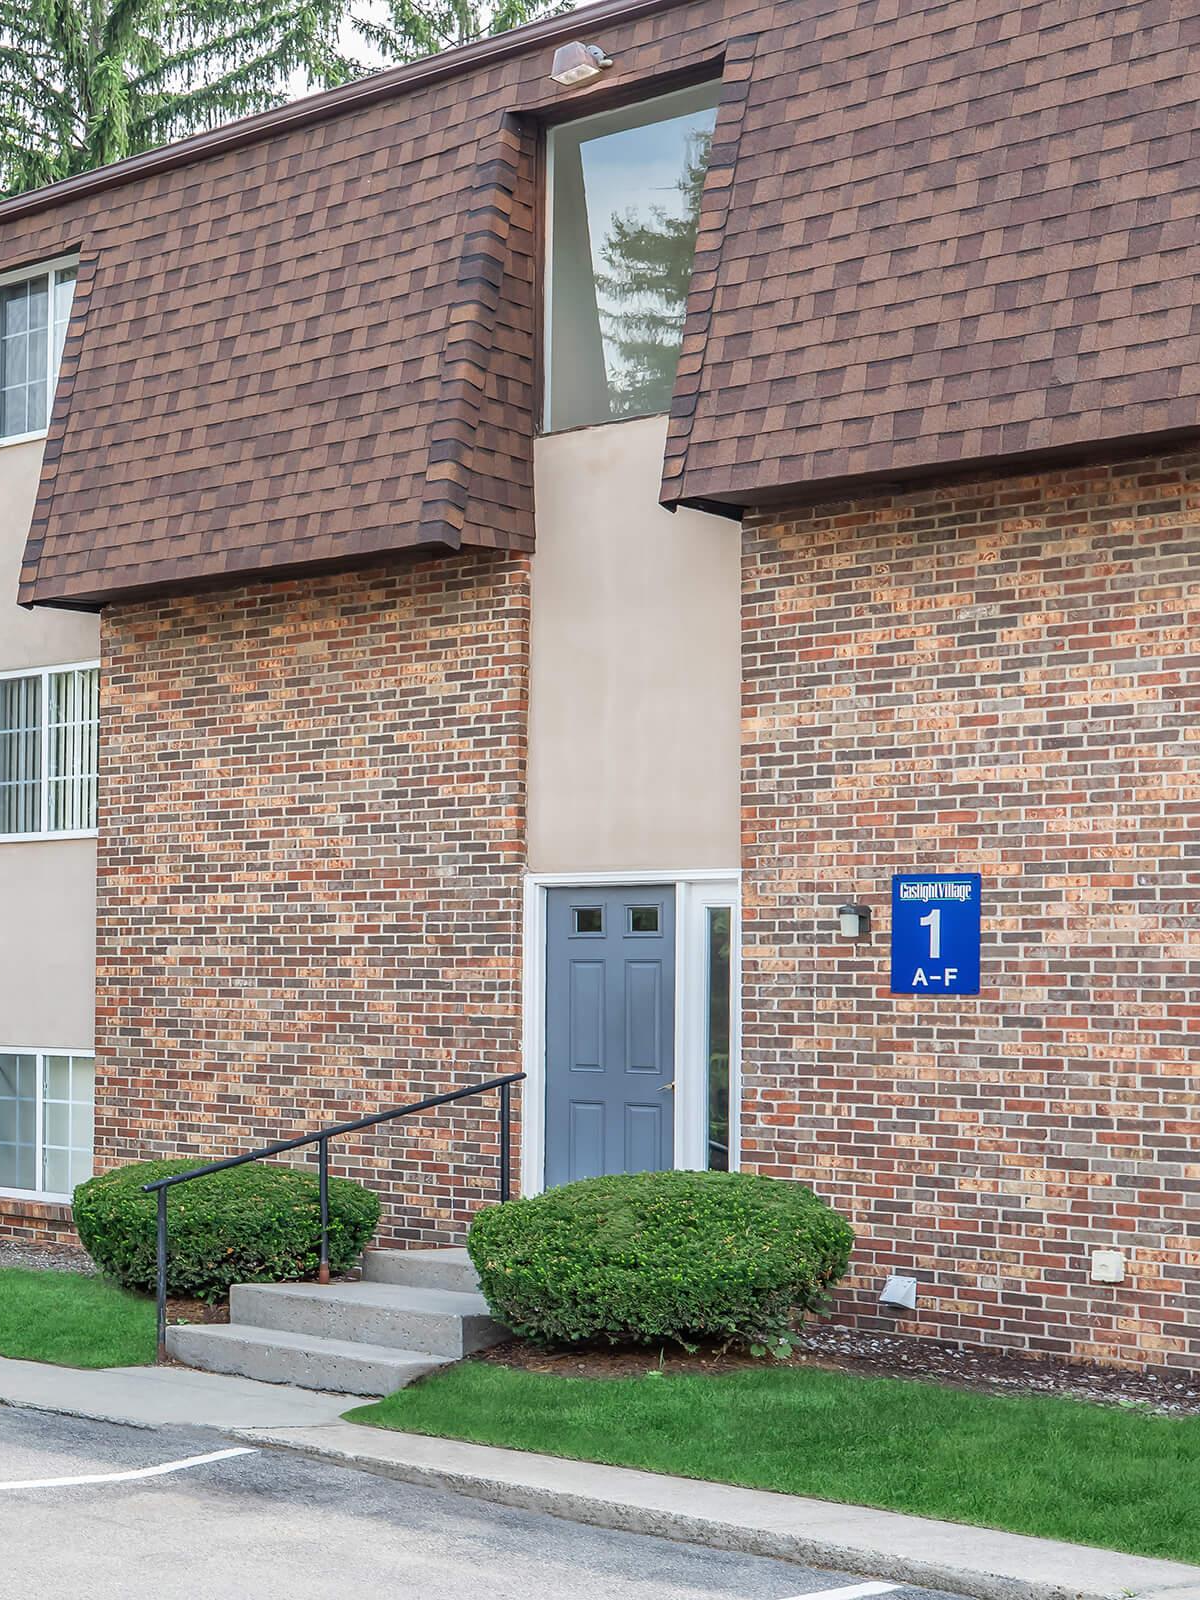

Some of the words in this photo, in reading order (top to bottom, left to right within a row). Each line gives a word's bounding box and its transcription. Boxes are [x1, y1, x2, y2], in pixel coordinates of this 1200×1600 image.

[900, 883, 938, 902] Gaslight
[938, 883, 971, 902] Village
[920, 909, 940, 958] 1
